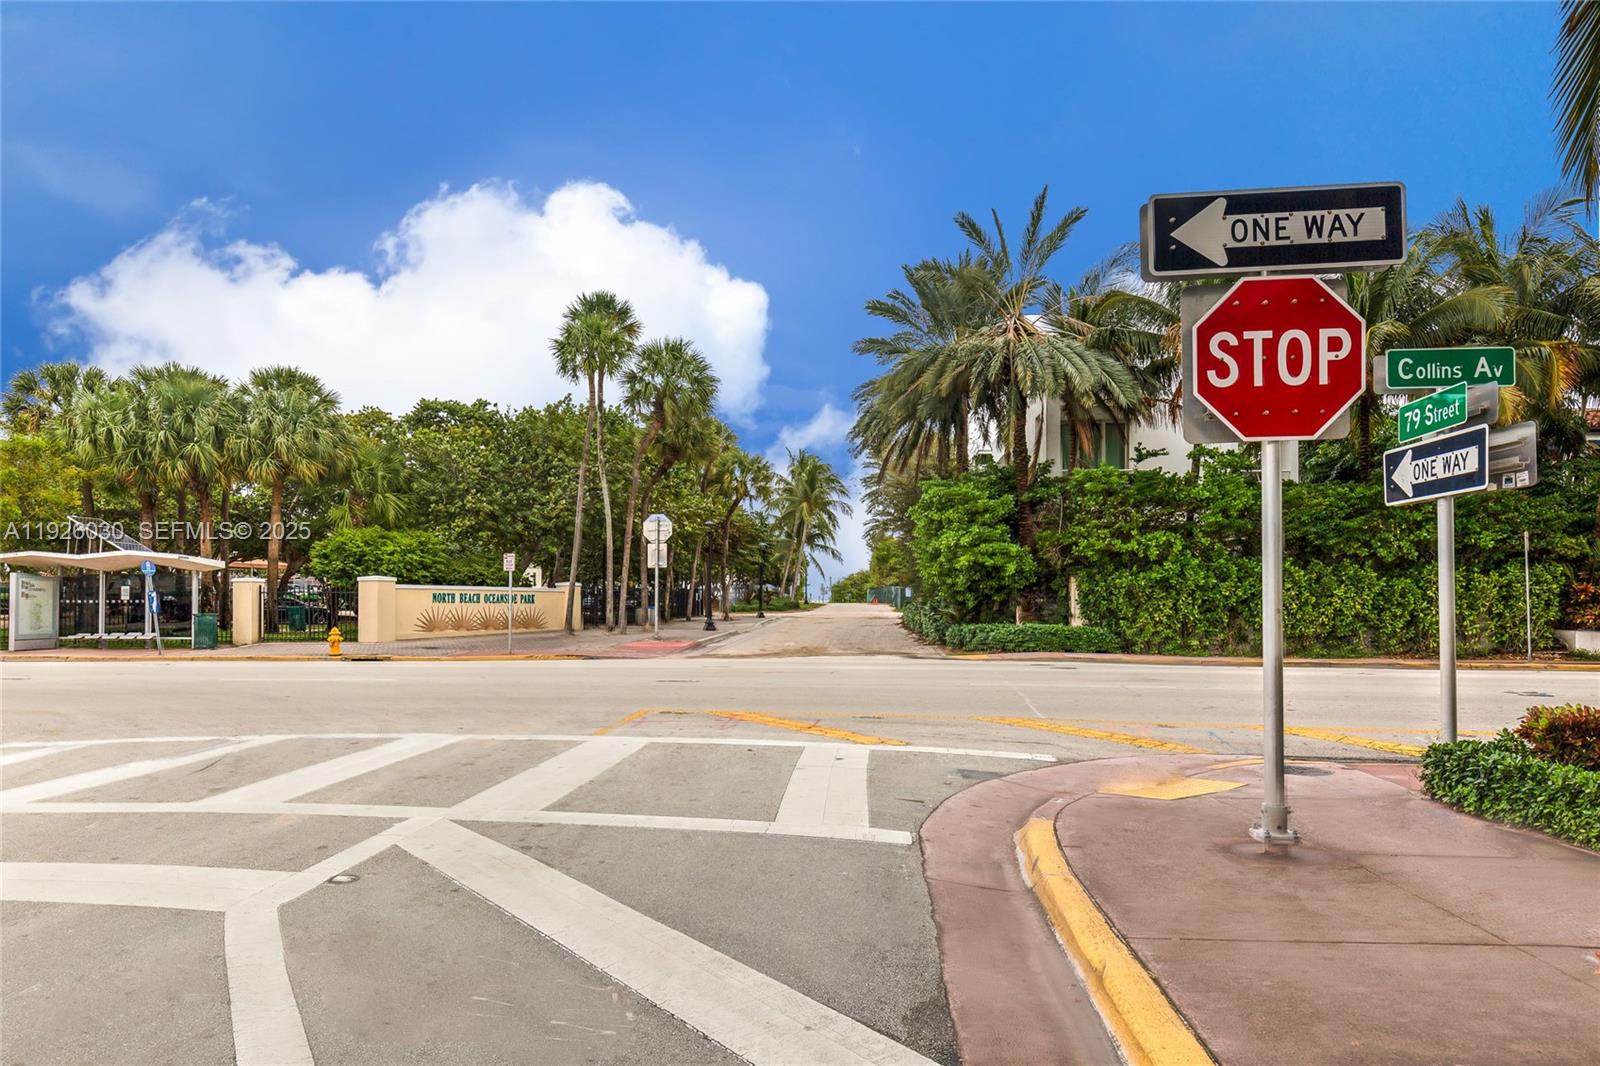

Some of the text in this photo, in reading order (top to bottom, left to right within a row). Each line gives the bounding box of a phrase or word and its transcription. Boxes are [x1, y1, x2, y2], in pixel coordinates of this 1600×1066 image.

[1231, 212, 1366, 244] ONE WAY
[1206, 327, 1352, 388] STOP
[1397, 356, 1504, 380] Collins Av
[1404, 399, 1461, 433] 79 Street
[1413, 450, 1470, 481] ONE WAY
[432, 592, 456, 604] NORTH
[459, 592, 481, 604] BEACH
[520, 594, 536, 605] PARK
